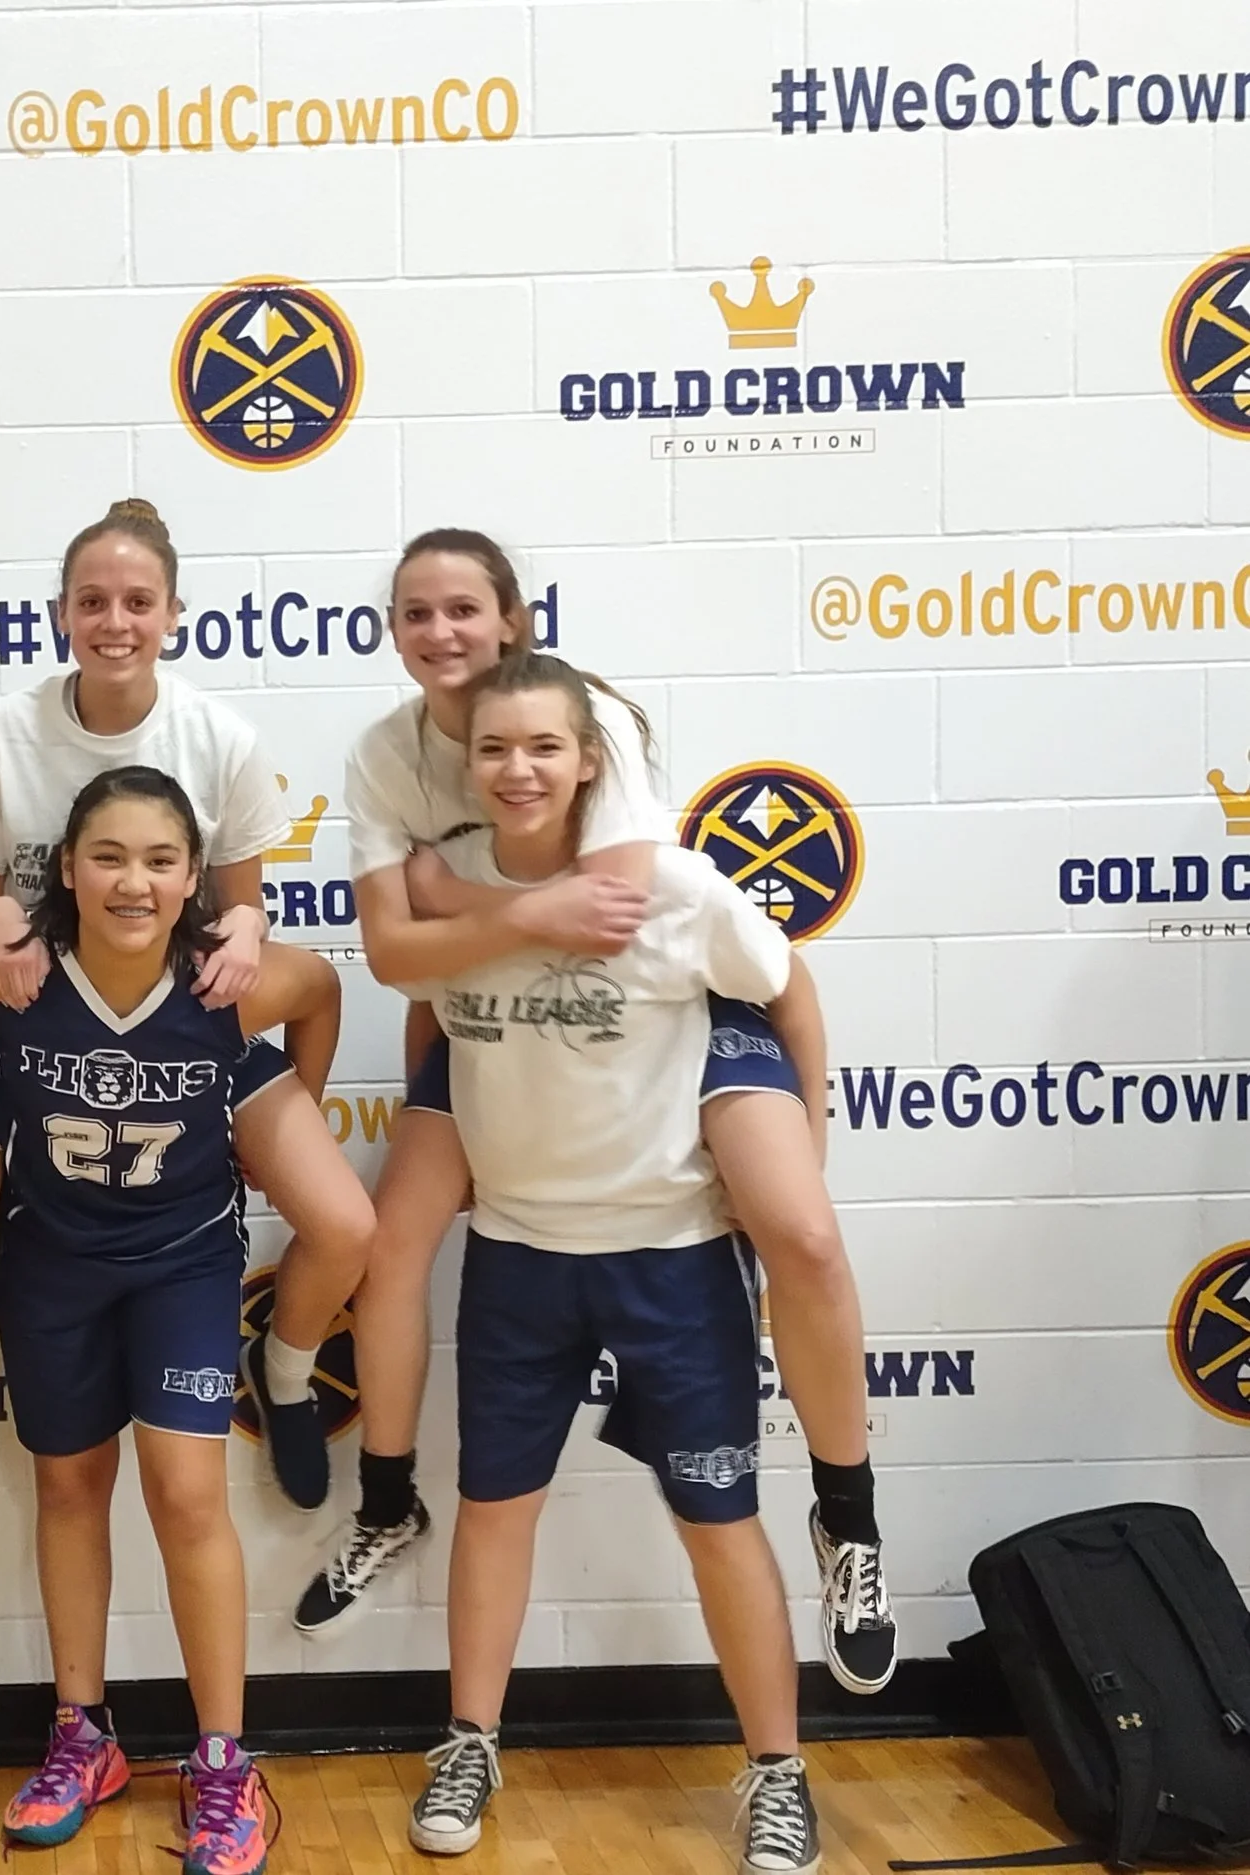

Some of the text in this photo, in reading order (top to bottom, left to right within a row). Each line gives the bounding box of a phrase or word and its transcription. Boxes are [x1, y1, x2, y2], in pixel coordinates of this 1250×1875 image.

[7, 76, 520, 158] @GoldCrownCO
[560, 361, 966, 421] GOLD CROWN
[663, 434, 864, 454] FOUNDATION
[1059, 855, 1209, 905] GOLD
[1161, 922, 1250, 938] FOUN
[20, 1044, 219, 1110] LIONS
[826, 1059, 1250, 1130] WeGotCrow
[42, 1112, 187, 1188] 27
[162, 1366, 237, 1402] LION
